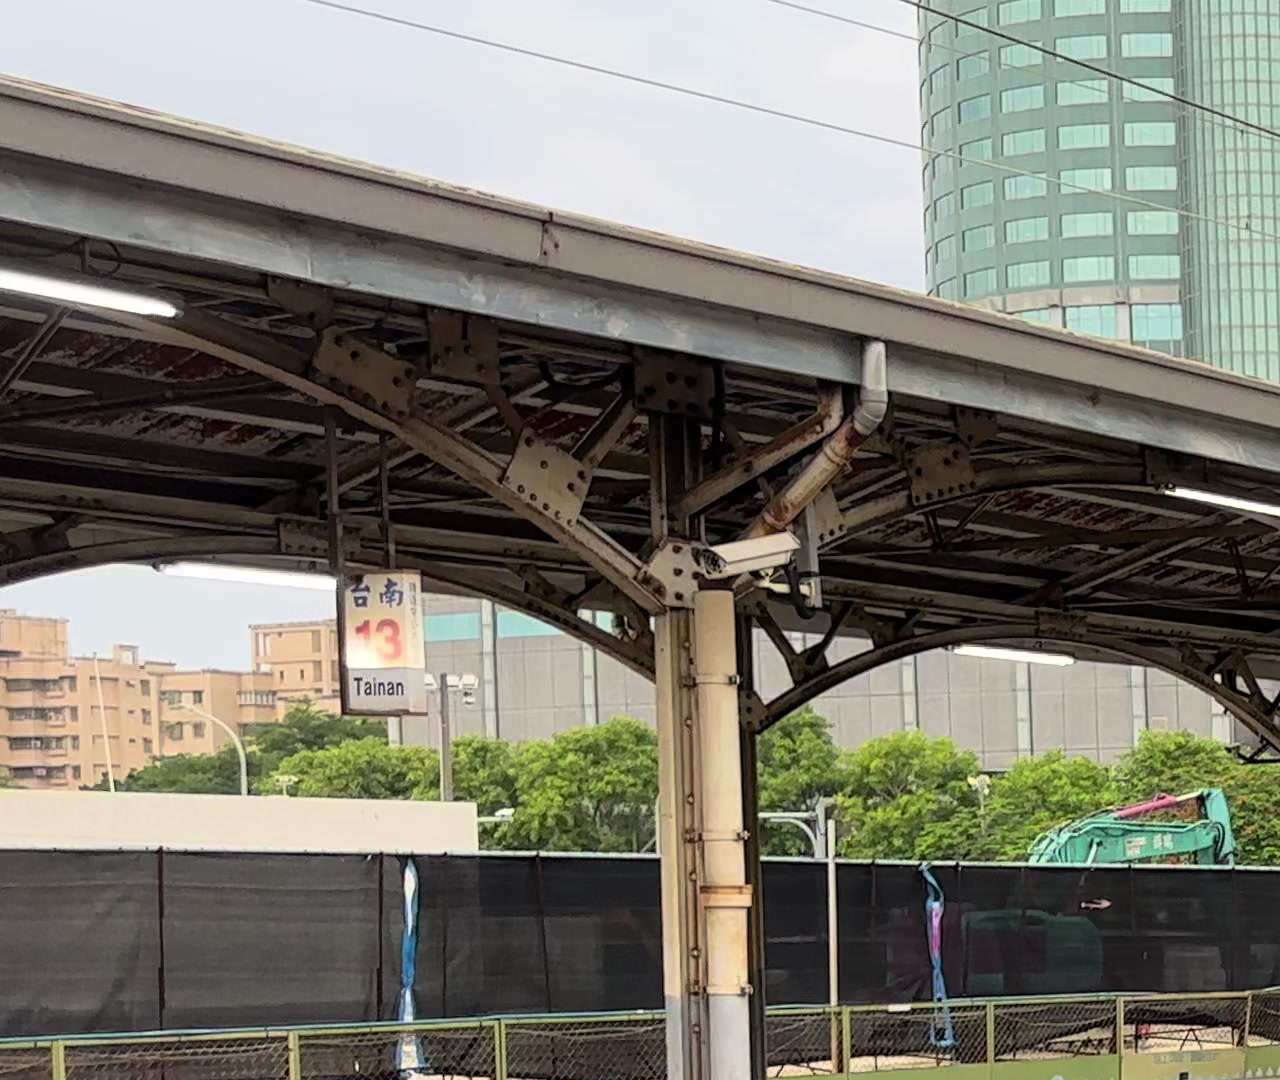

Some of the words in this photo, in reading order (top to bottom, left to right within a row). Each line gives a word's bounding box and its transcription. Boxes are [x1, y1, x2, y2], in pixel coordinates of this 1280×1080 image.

[350, 577, 404, 608] 台南
[355, 618, 402, 661] 13
[353, 677, 404, 696] Tainan
